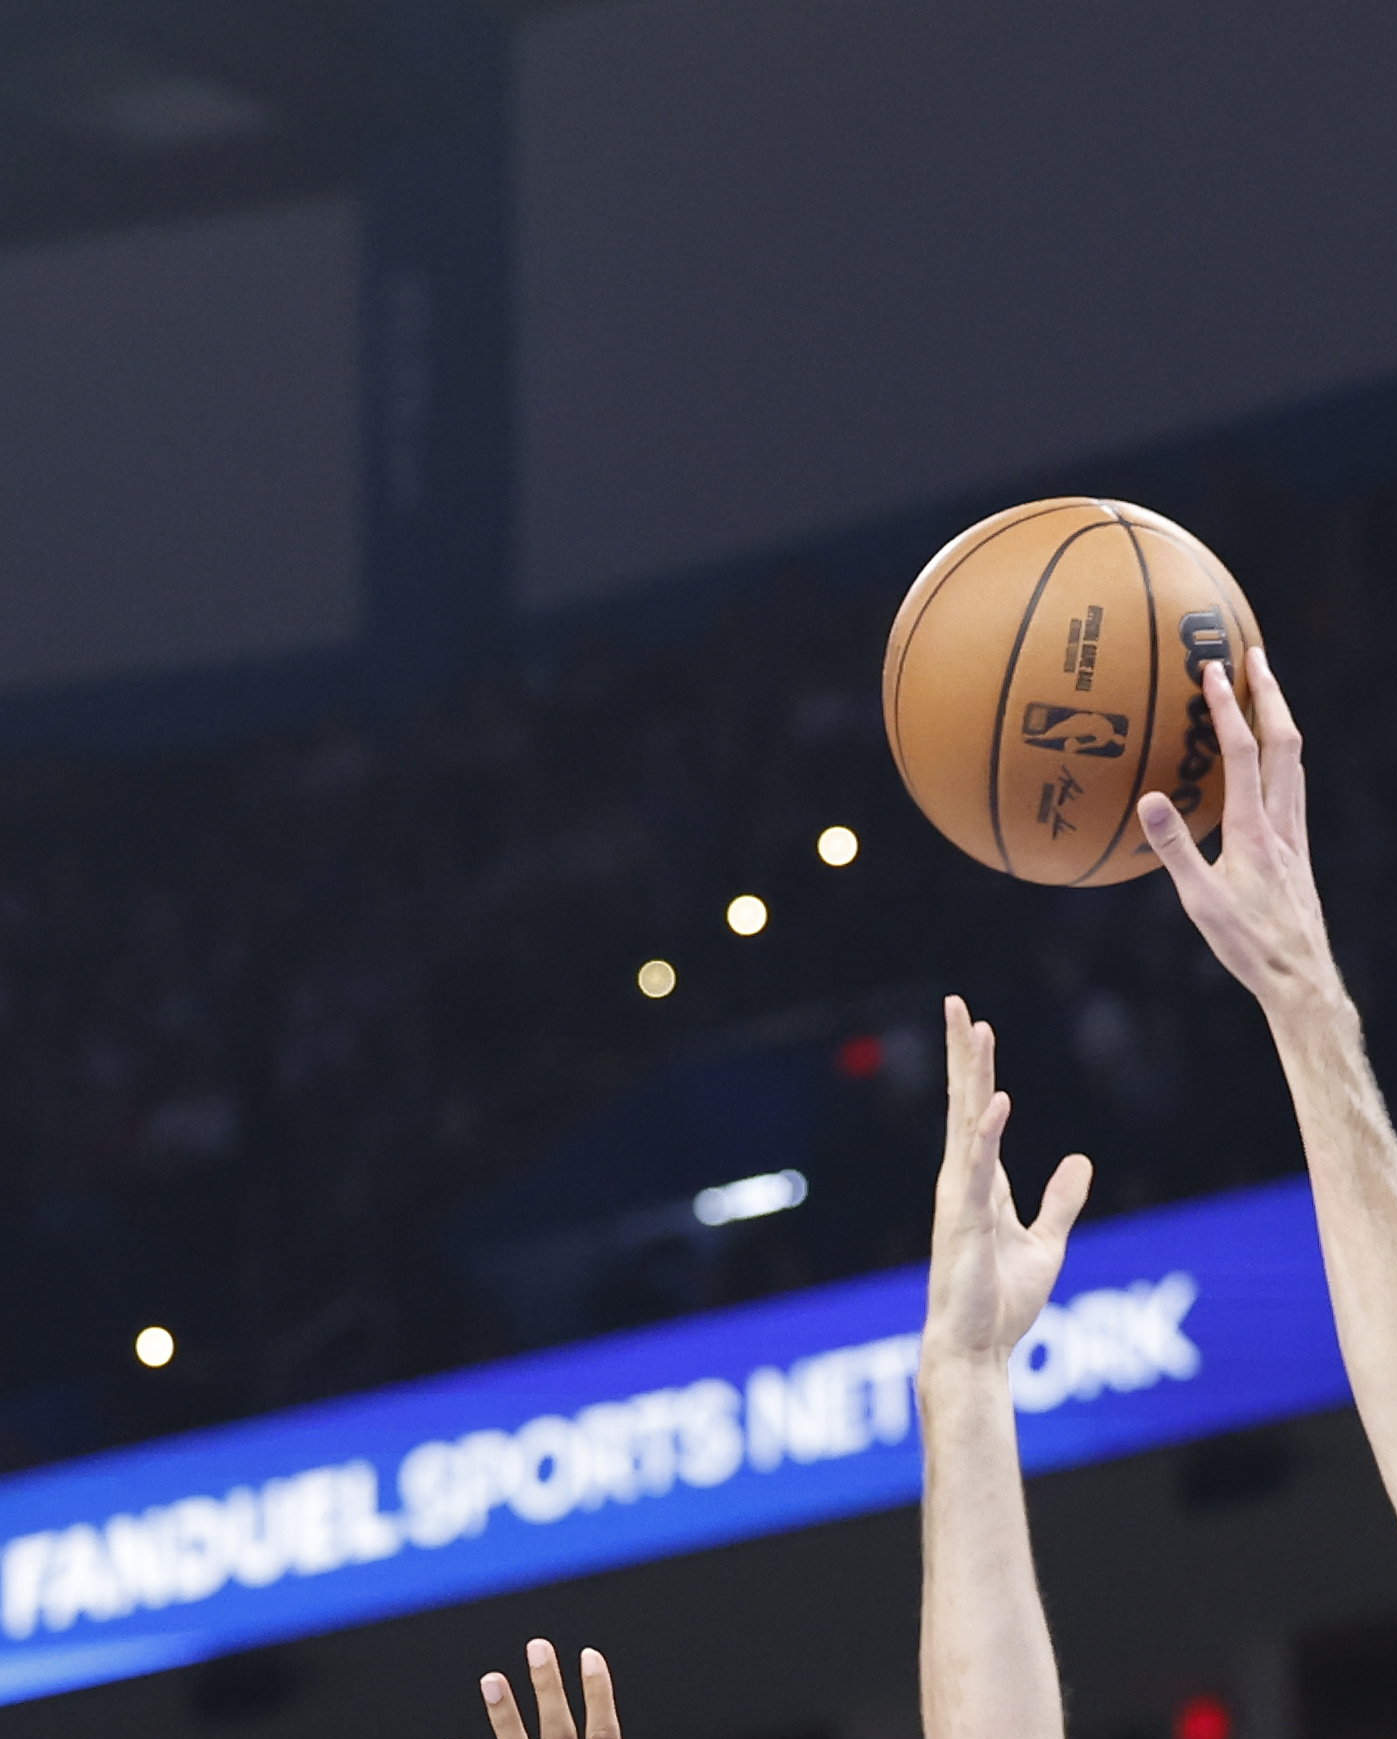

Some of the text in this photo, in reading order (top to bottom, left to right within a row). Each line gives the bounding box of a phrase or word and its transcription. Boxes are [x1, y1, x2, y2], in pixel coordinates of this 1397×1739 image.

[3, 1272, 1200, 1640] FANDUEL SPORTS NETORK
